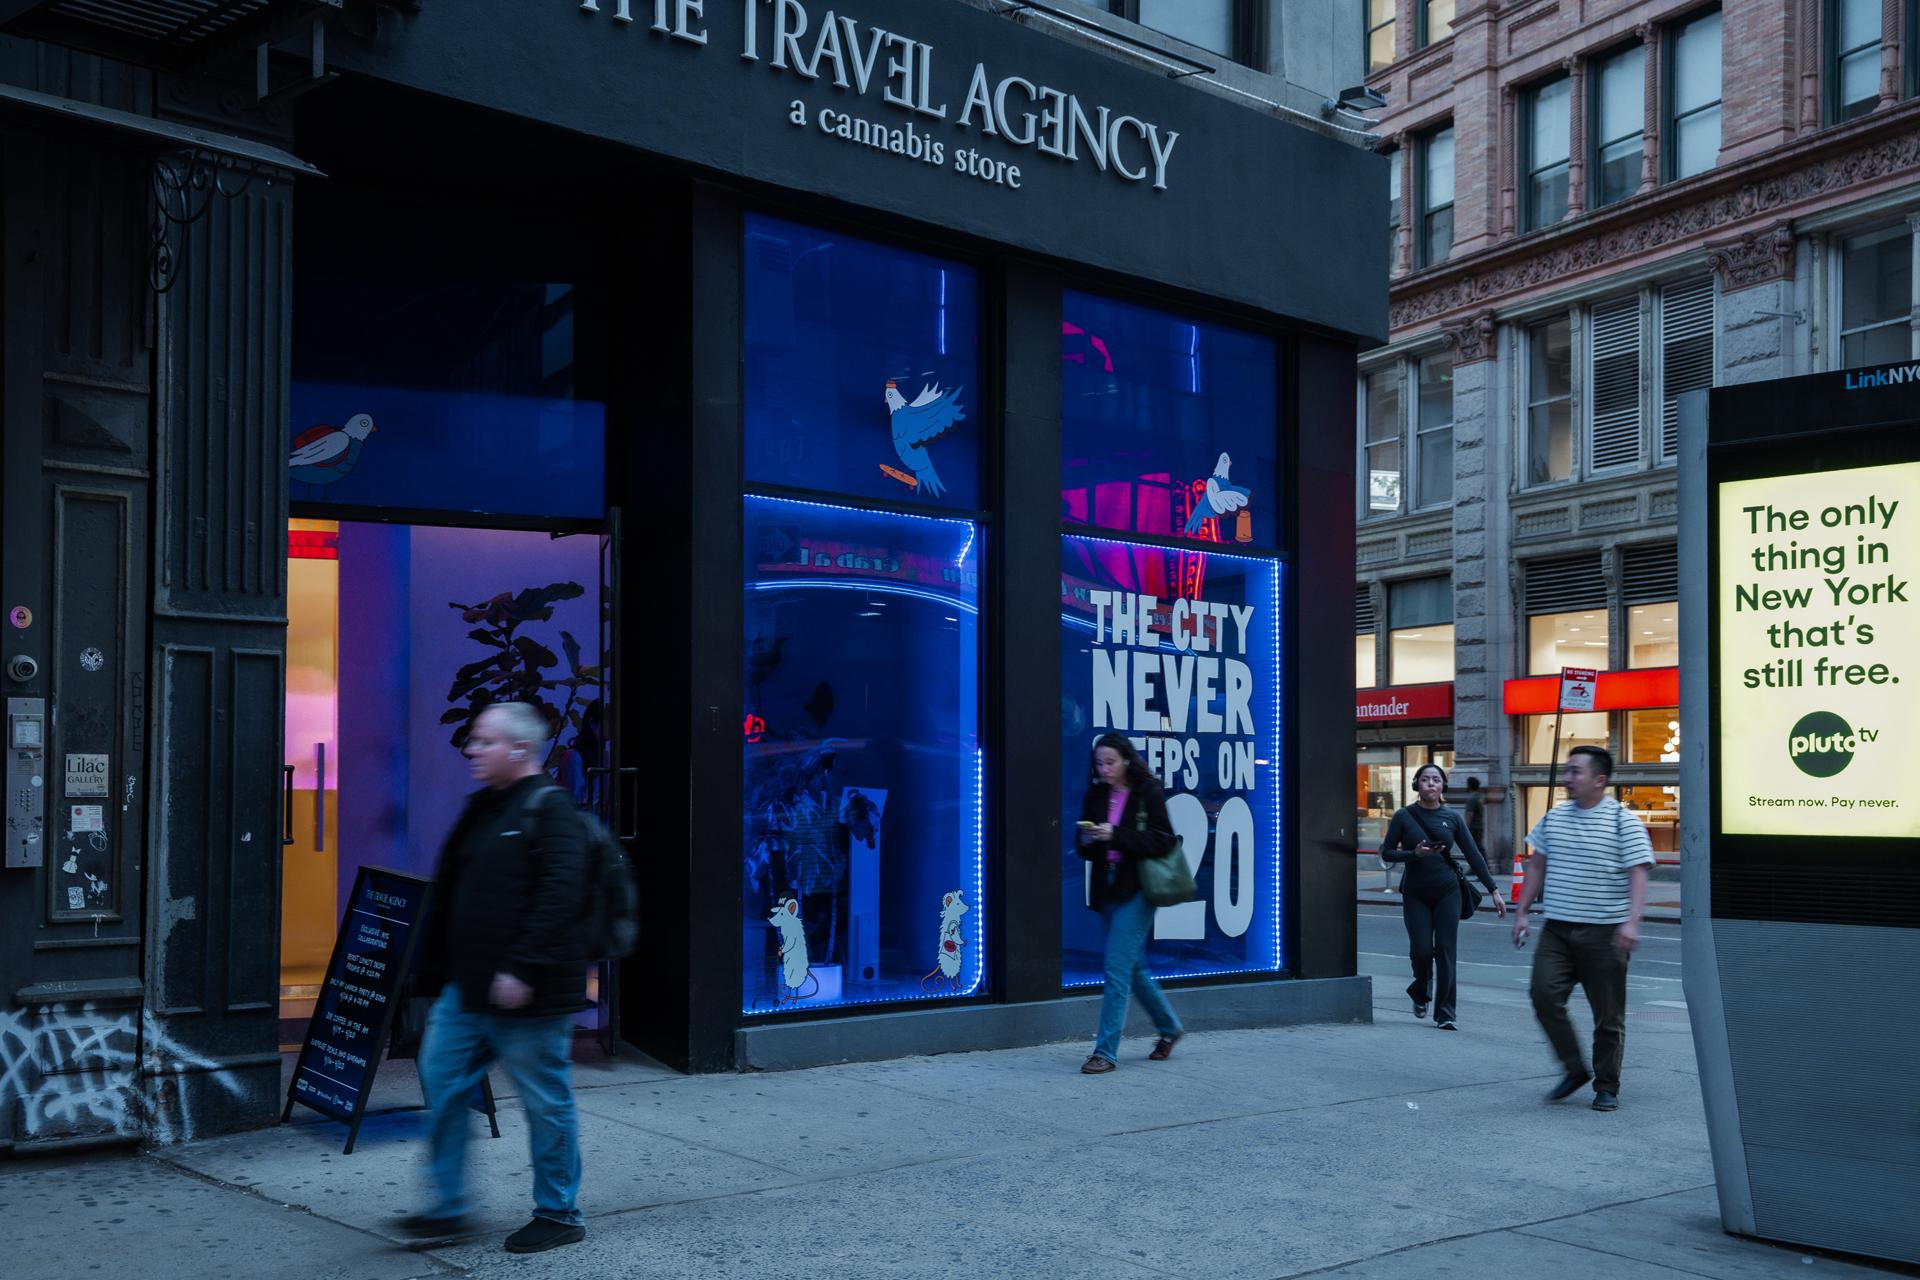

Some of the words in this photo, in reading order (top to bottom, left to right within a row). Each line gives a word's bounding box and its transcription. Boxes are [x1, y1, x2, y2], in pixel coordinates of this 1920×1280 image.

[741, 0, 946, 118] TRAVEL
[956, 62, 1180, 190] AGENCY
[789, 99, 806, 126] a
[818, 107, 944, 166] cannabis
[954, 147, 1022, 189] store
[1743, 504, 1810, 534] The
[1820, 495, 1899, 529] only
[1752, 540, 1845, 574] thing
[1857, 535, 1889, 565] in
[1735, 583, 1814, 612] New
[1823, 573, 1909, 606] York
[1090, 590, 1161, 648] THE
[1171, 597, 1255, 655] CITY
[1766, 614, 1875, 649] that's
[1092, 648, 1256, 736] NEVER
[1743, 658, 1803, 689] still
[1814, 656, 1900, 687] free.
[1356, 696, 1409, 717] ntander
[1791, 731, 1856, 757] pluto
[1858, 726, 1879, 742] tv
[68, 757, 104, 773] Lilac
[68, 776, 104, 784] GALLERY
[1217, 740, 1255, 790] ON
[1749, 796, 1795, 807] Stream
[1798, 798, 1828, 808] now.
[1831, 796, 1856, 809] Pay
[1858, 797, 1899, 809] never.
[1086, 793, 1255, 940] 20
